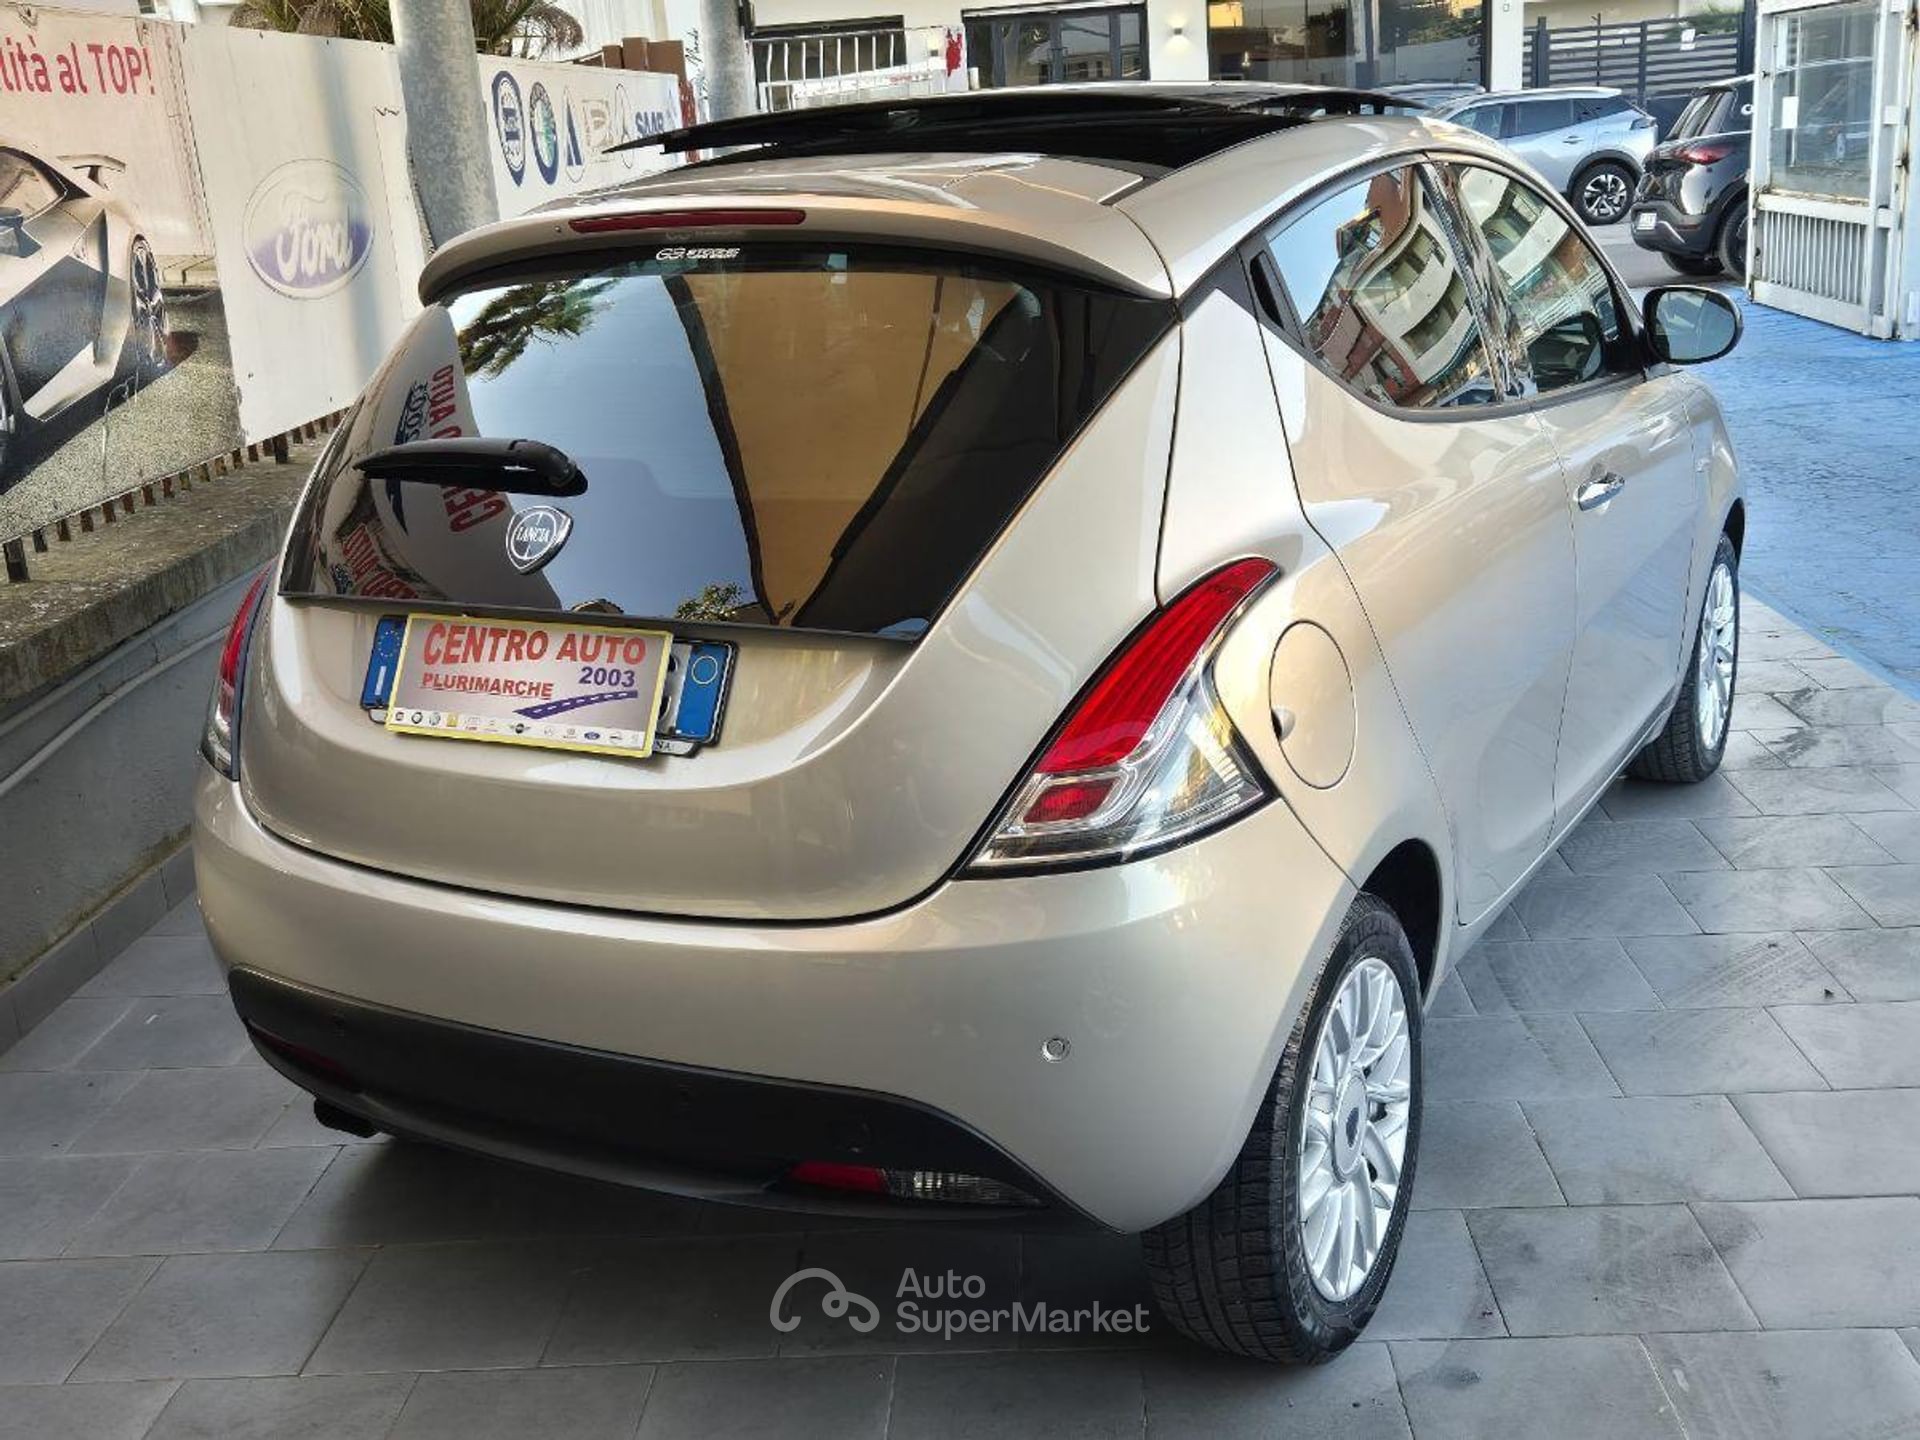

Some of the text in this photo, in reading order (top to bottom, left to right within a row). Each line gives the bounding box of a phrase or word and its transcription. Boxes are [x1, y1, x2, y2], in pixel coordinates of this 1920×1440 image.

[56, 42, 88, 94] al
[87, 44, 155, 95] TOP!
[276, 190, 353, 282] Ford
[515, 526, 551, 542] LANCIA
[423, 622, 647, 666] CENTRO AUTO
[421, 671, 555, 700] PLURIMARCHE
[578, 665, 636, 688] 2003
